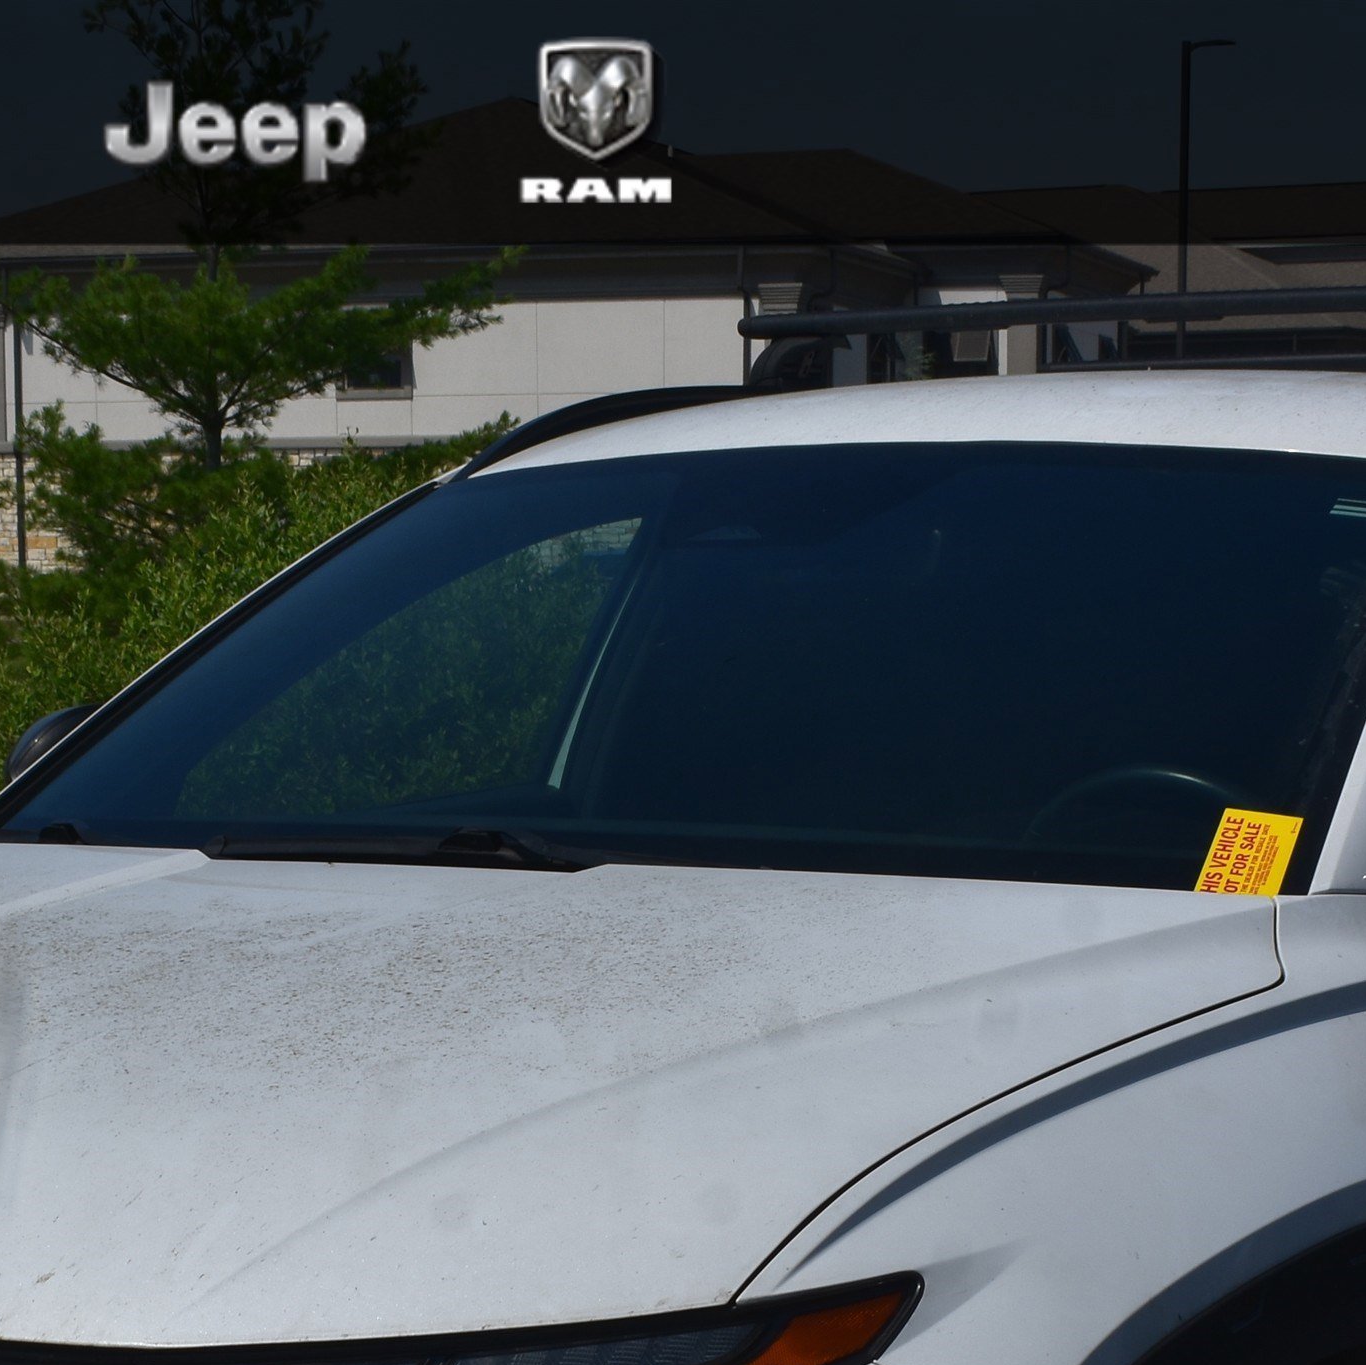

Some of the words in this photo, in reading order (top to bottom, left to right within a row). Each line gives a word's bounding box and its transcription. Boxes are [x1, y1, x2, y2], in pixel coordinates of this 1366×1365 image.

[1209, 816, 1245, 868] VEHICLE
[1240, 822, 1262, 851] SALE
[1230, 854, 1250, 877] FOR
[1201, 871, 1223, 893] HIS
[1224, 879, 1240, 893] OT
